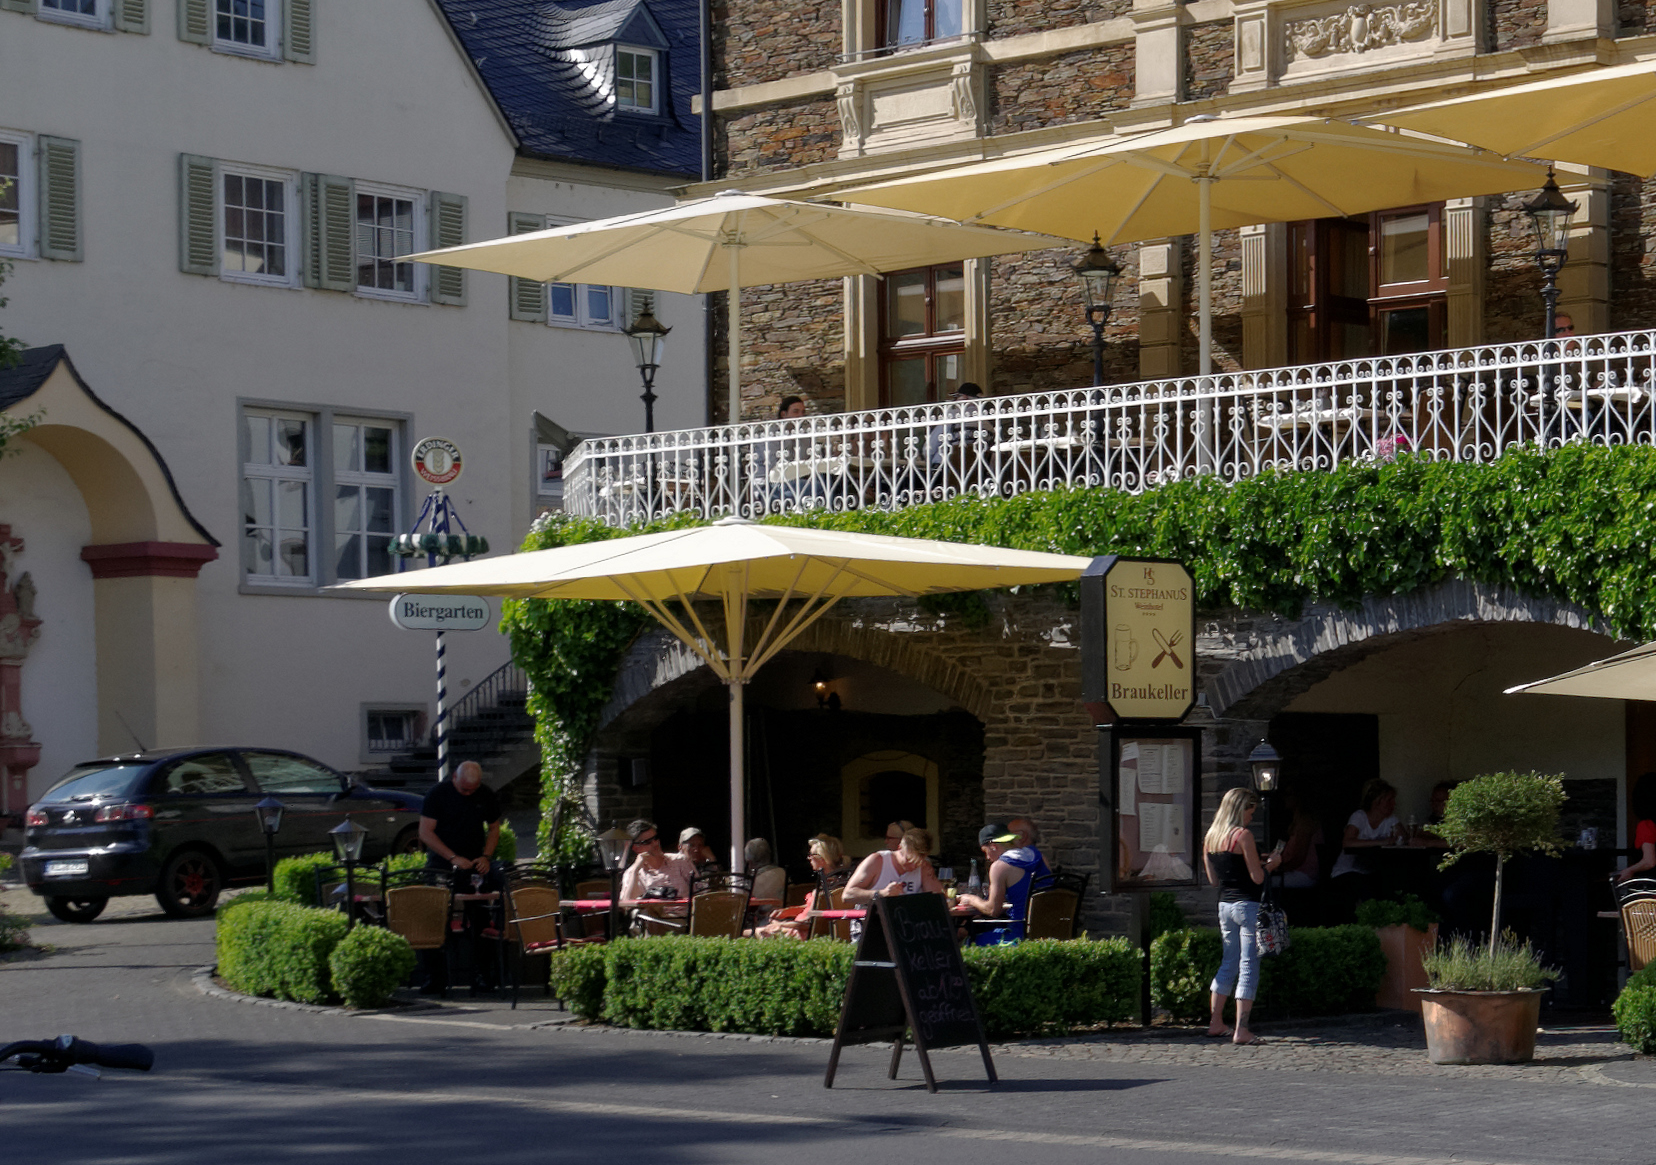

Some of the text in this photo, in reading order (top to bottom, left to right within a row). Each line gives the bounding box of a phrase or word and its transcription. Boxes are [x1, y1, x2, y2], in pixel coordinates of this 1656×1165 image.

[1127, 588, 1188, 601] STEPHANUS
[404, 602, 483, 622] Biergarten
[1111, 683, 1189, 702] Braukeller
